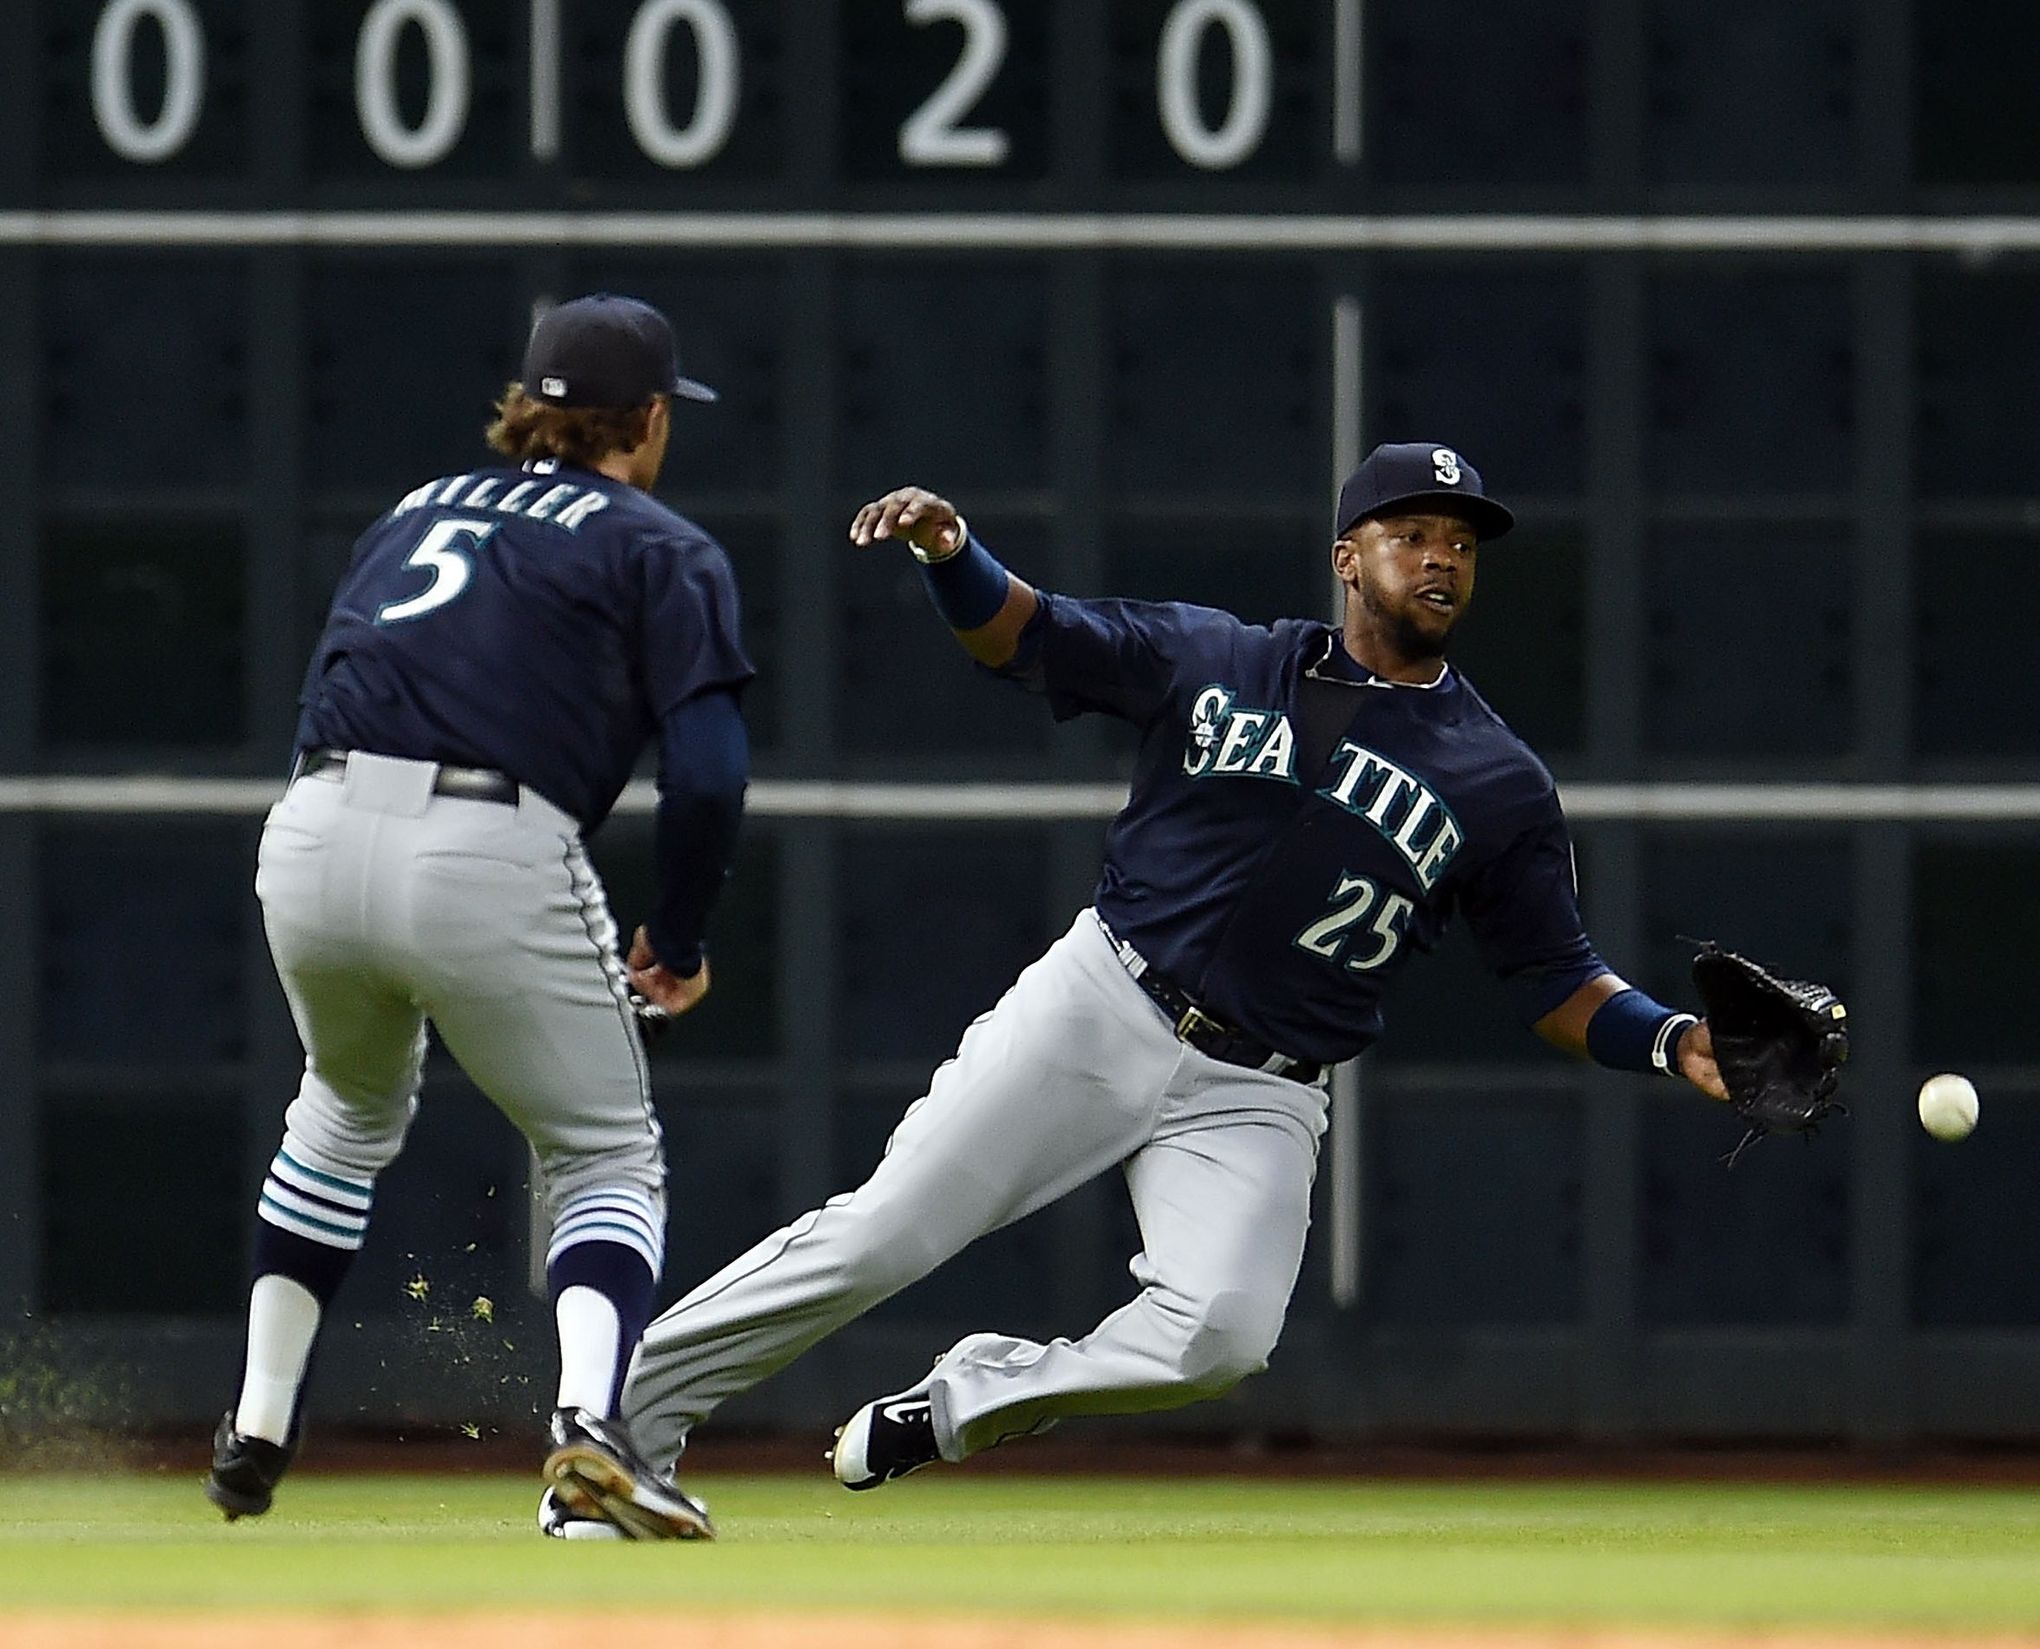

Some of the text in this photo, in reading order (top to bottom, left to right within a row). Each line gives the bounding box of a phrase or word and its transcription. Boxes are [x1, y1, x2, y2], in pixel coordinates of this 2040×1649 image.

[91, 0, 1272, 169] 0 0 0 2 0
[376, 518, 499, 626] 5
[1292, 869, 1415, 971] 25
